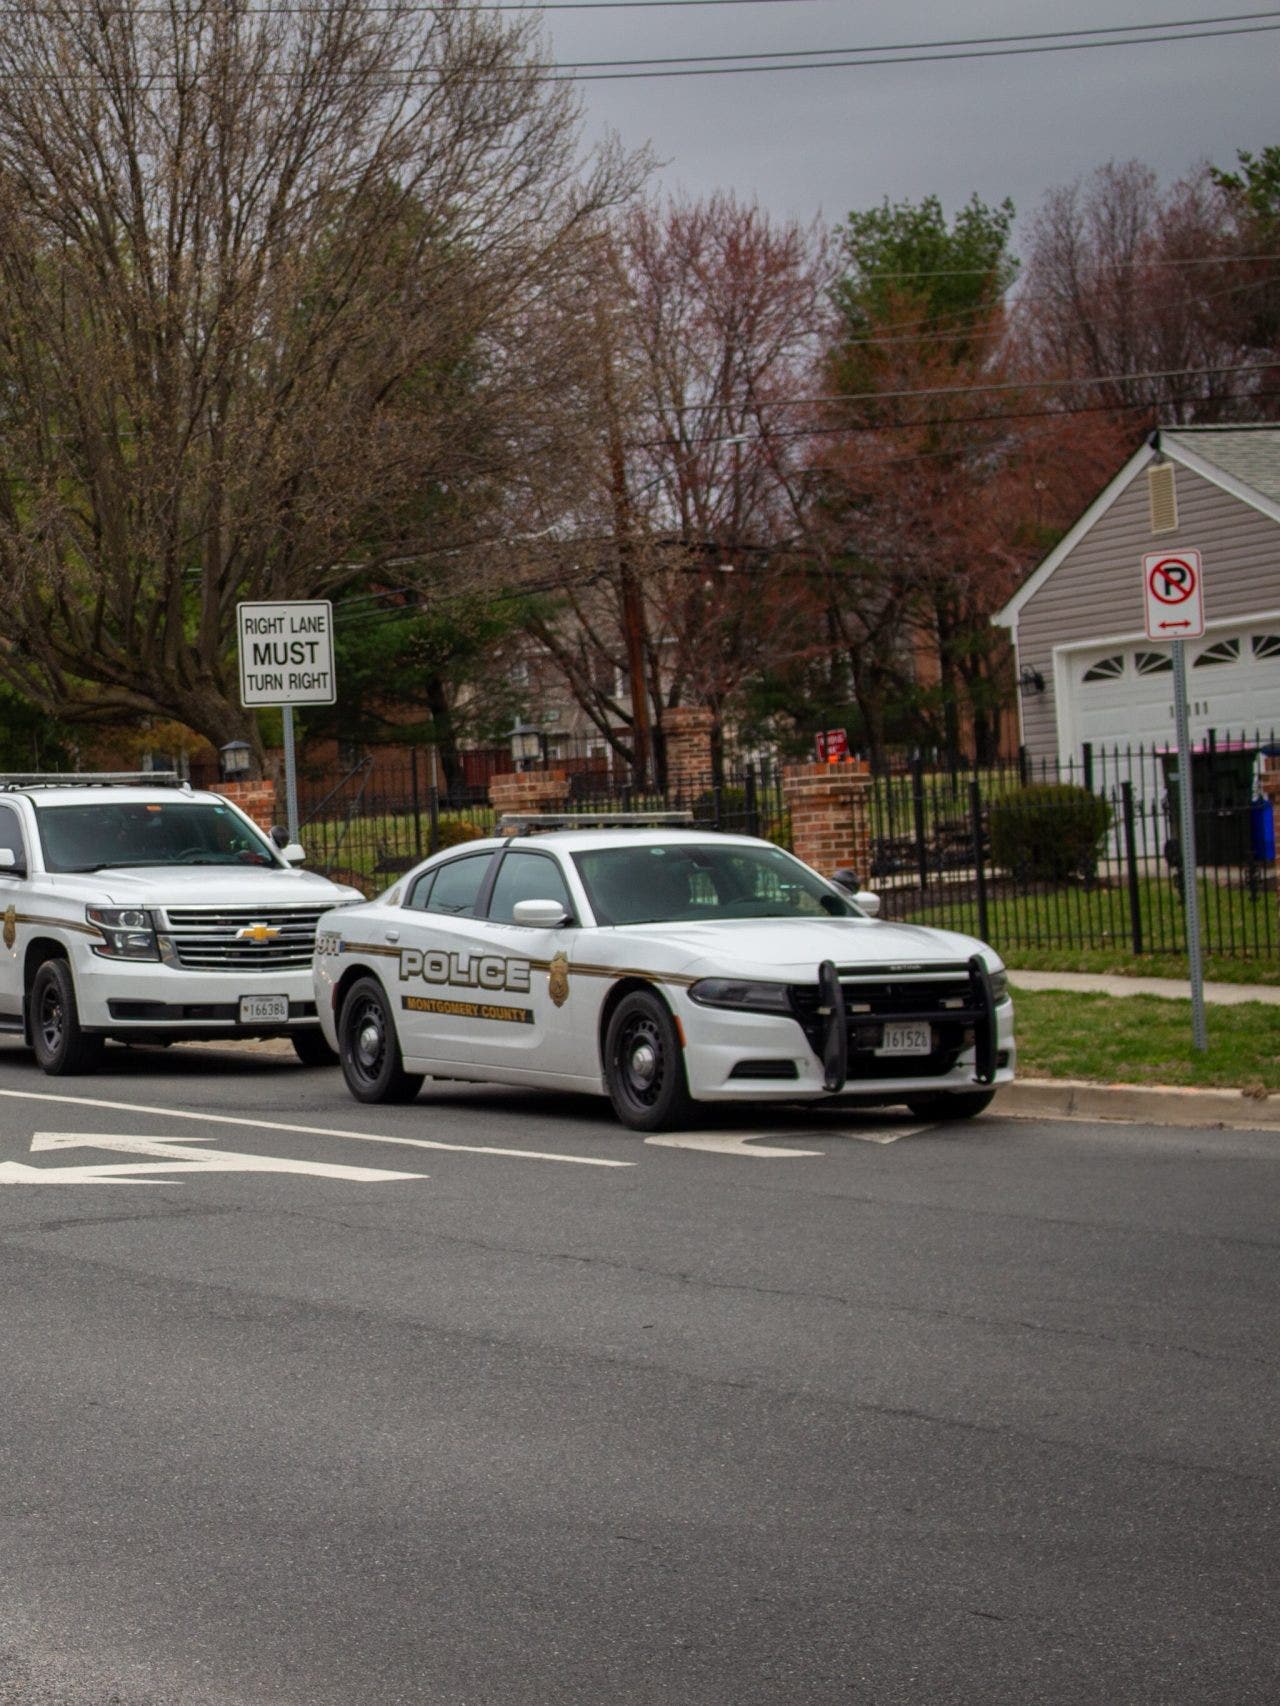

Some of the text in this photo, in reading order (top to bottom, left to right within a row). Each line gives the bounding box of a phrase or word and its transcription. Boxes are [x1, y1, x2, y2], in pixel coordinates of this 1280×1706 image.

[245, 616, 326, 635] RIGHT LANE
[252, 641, 319, 666] MUST
[247, 672, 329, 691] TURN RIGHT
[399, 949, 532, 993] POLICE
[407, 998, 526, 1024] MONTGOMERY COUNTY
